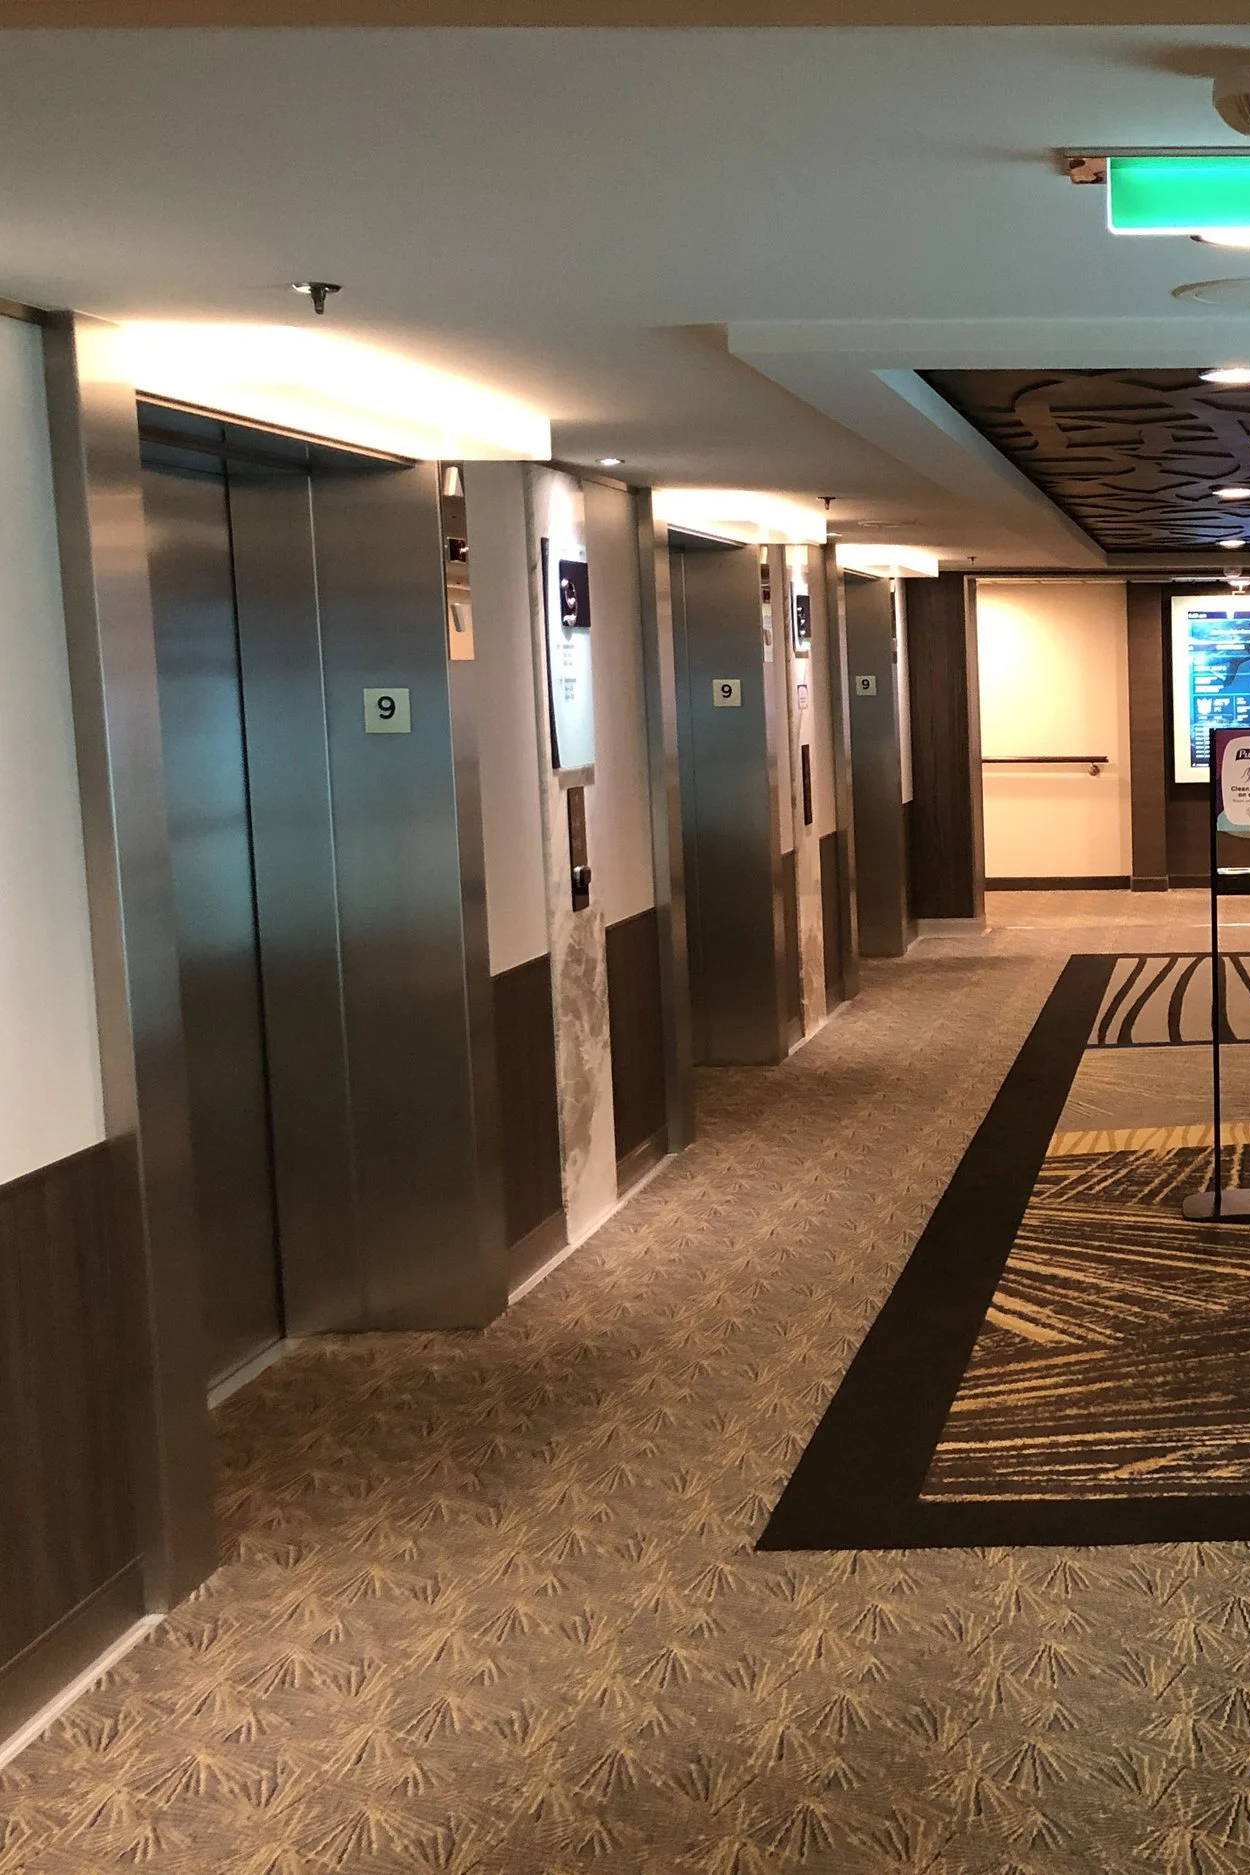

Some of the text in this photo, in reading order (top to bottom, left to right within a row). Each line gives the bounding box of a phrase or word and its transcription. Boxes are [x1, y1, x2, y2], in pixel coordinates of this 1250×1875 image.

[720, 683, 733, 699] 9
[861, 678, 870, 690] 9
[377, 695, 396, 720] 9
